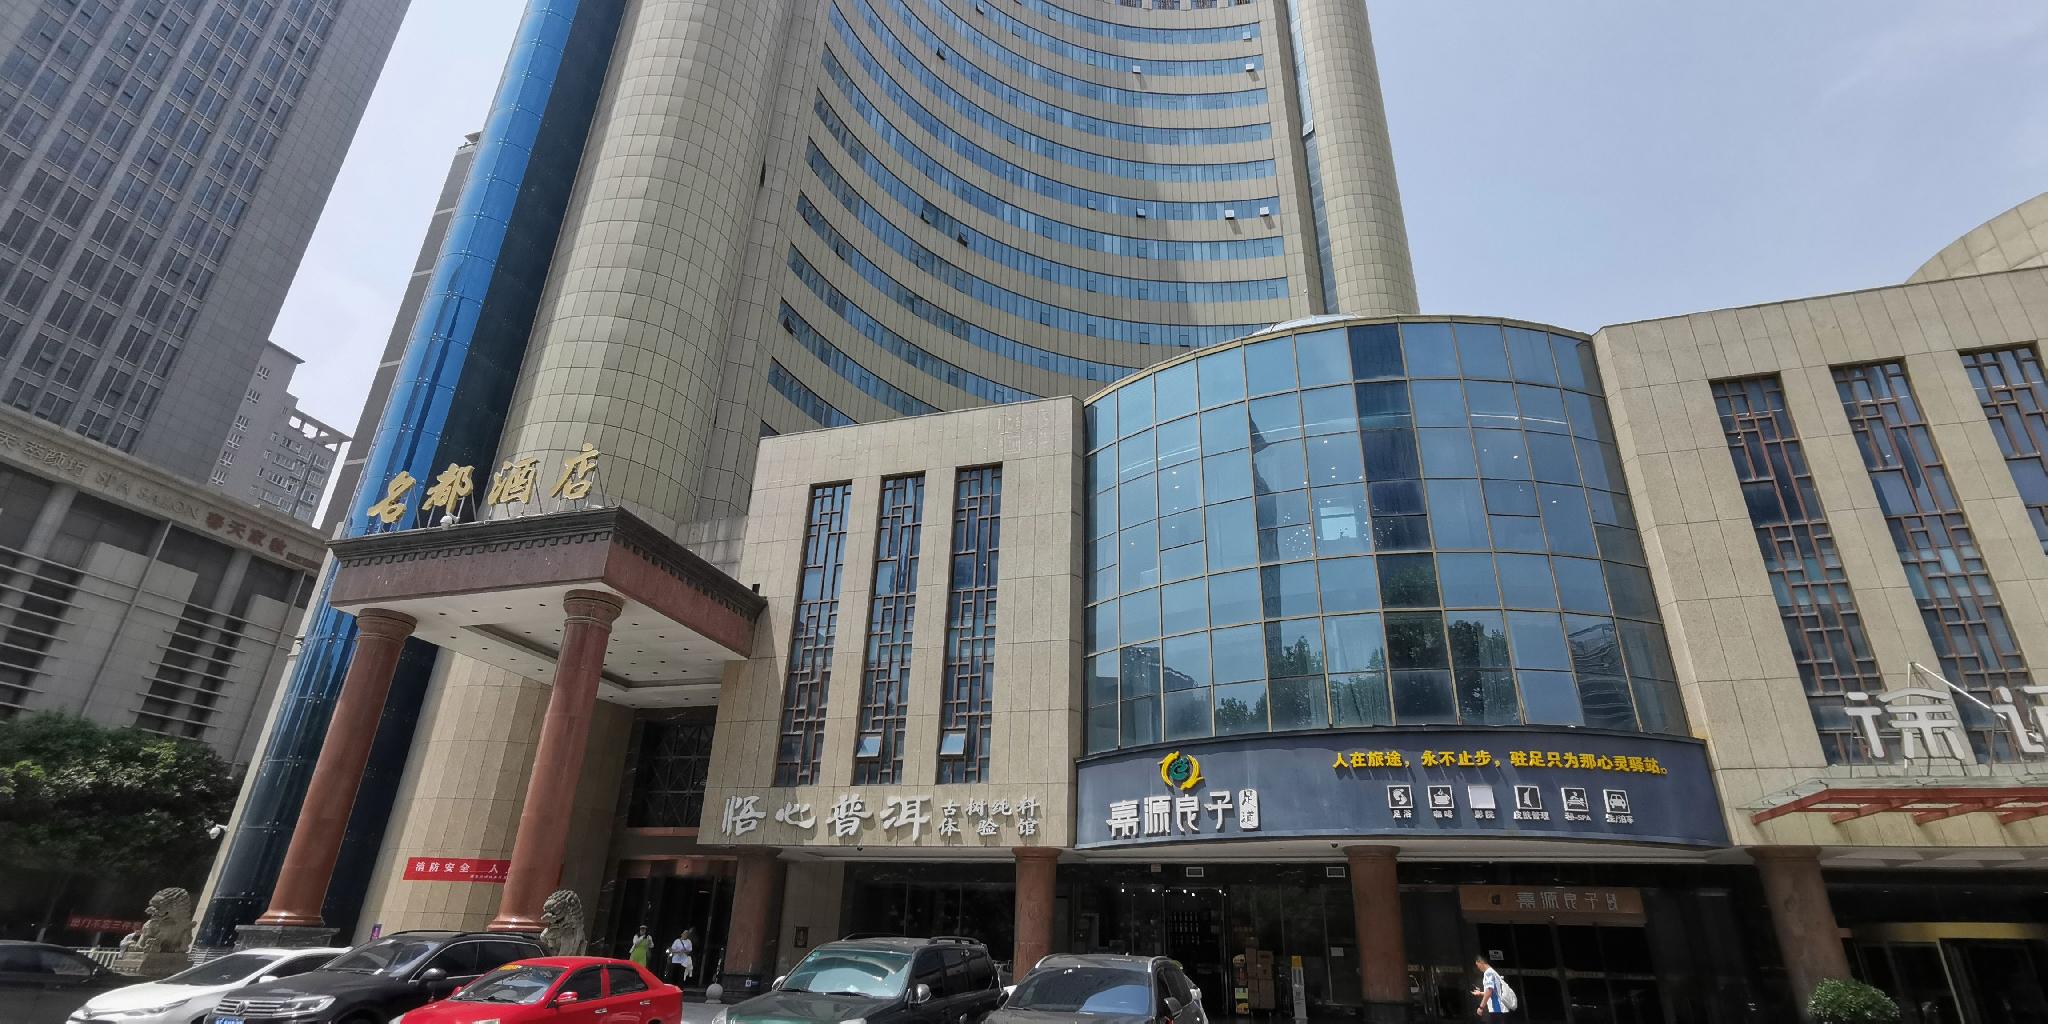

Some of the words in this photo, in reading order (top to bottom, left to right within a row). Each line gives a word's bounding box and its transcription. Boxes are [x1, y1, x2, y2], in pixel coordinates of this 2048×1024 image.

[367, 443, 601, 523] 名都酒店
[721, 794, 931, 842] 悟心普洱
[938, 816, 1040, 837] 体验馆
[1106, 790, 1232, 838] 嘉源良子
[1393, 809, 1412, 819] 足浴
[415, 861, 470, 873] 消防安全
